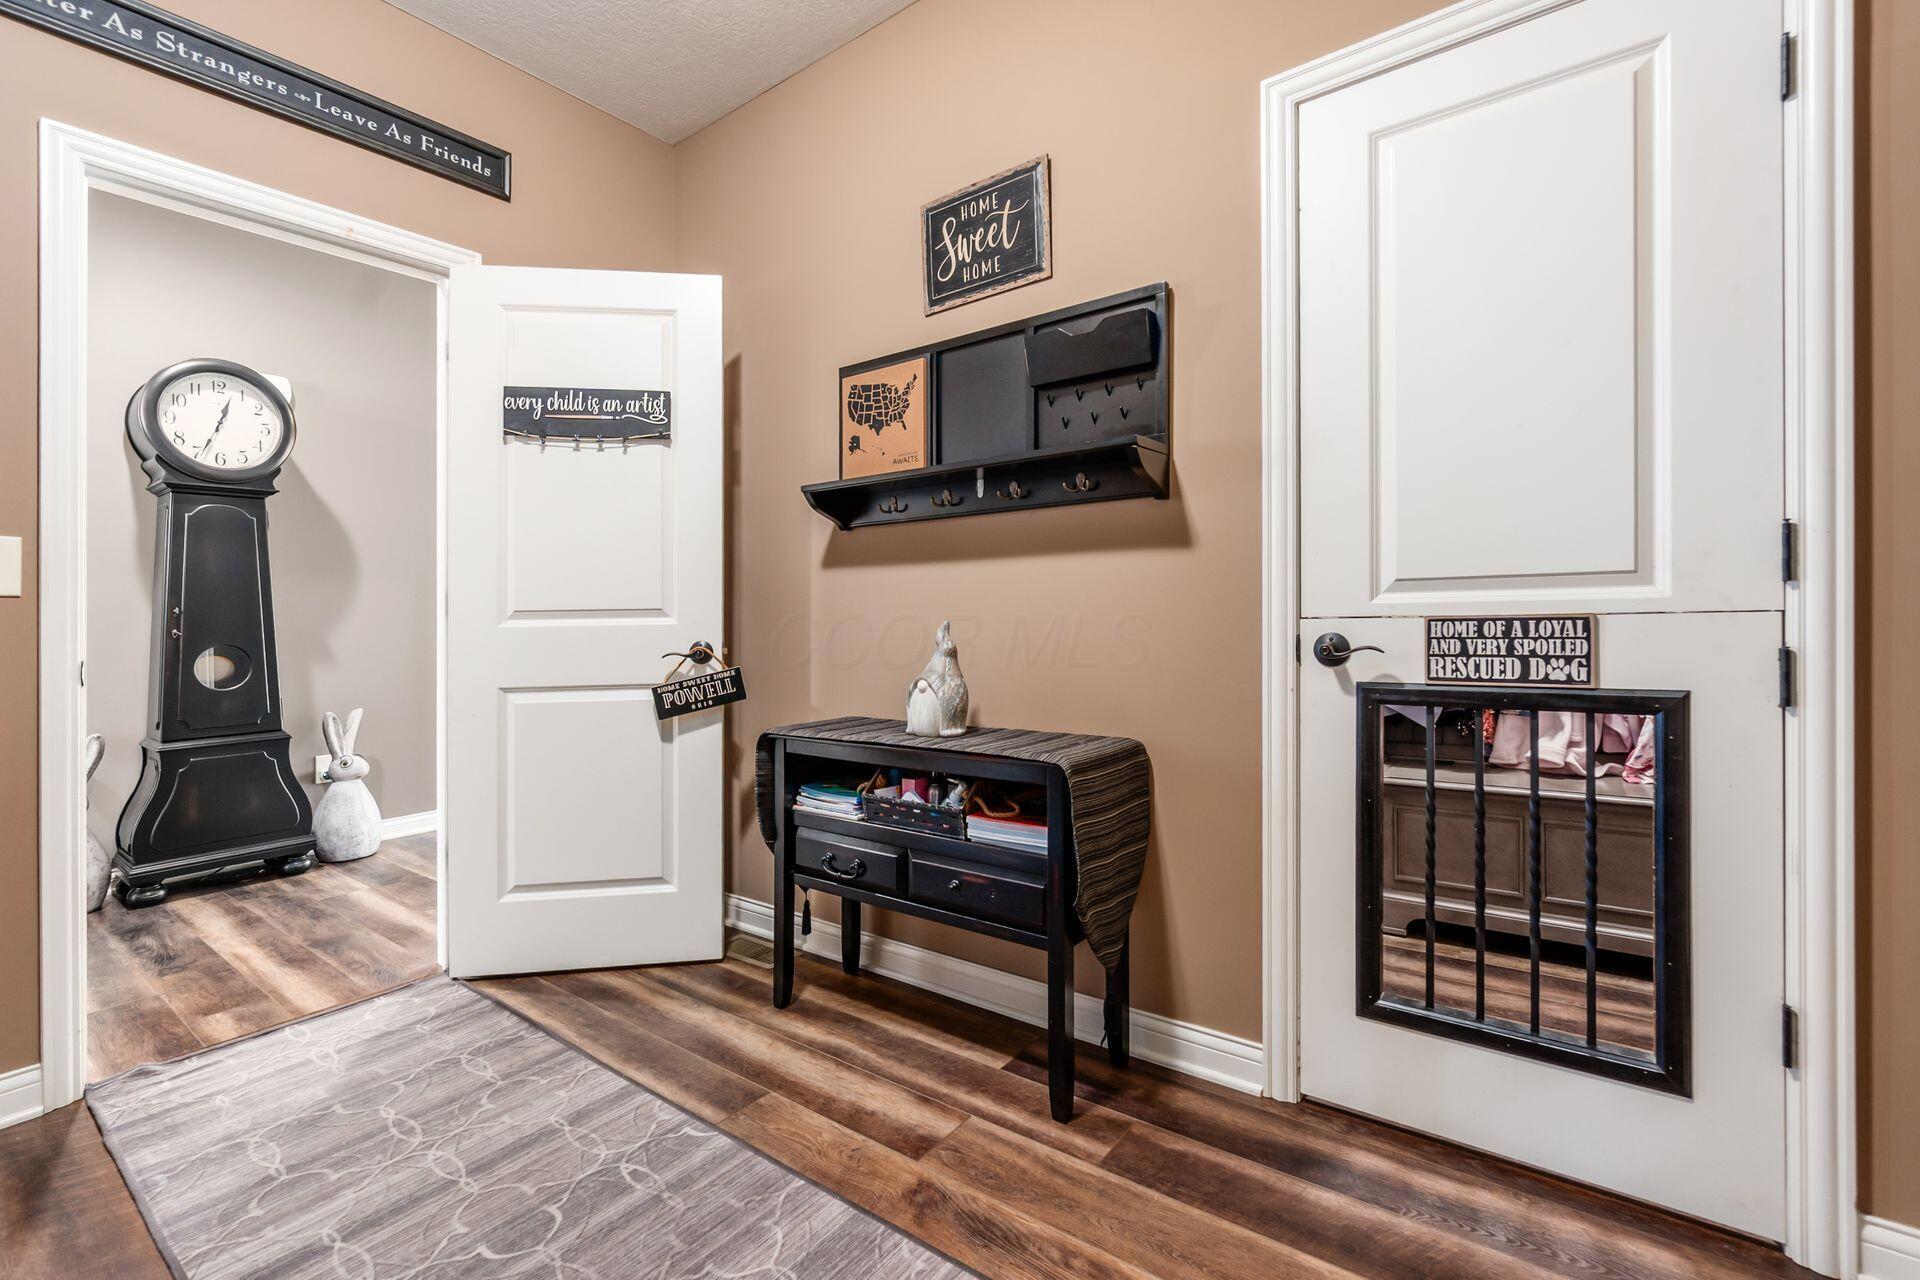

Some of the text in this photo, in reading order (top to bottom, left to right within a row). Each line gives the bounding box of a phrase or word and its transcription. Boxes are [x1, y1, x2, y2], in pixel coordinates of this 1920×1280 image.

[32, 0, 492, 177] ter As Strangers Leave As Friends
[961, 191, 1000, 222] HOME
[935, 199, 1030, 282] Sweet
[963, 255, 1001, 283] HOME
[190, 382, 201, 395] 11
[212, 380, 226, 394] 12
[172, 392, 187, 407] 10
[240, 389, 245, 402] 1
[254, 403, 264, 416] 2
[504, 390, 667, 420] every child is an artist
[164, 410, 176, 424] 9
[260, 423, 271, 436] 3
[173, 431, 186, 446] 8
[215, 452, 226, 466] 6
[237, 450, 249, 464] 5
[893, 454, 919, 465] AWAITS
[1429, 619, 1588, 638] HOME OF A LOYAL
[1429, 639, 1589, 656] AND VERY SPOILED
[1429, 656, 1589, 682] RESCUED DG
[657, 669, 737, 694] HOME SWEET HOME
[661, 677, 737, 709] POWELL
